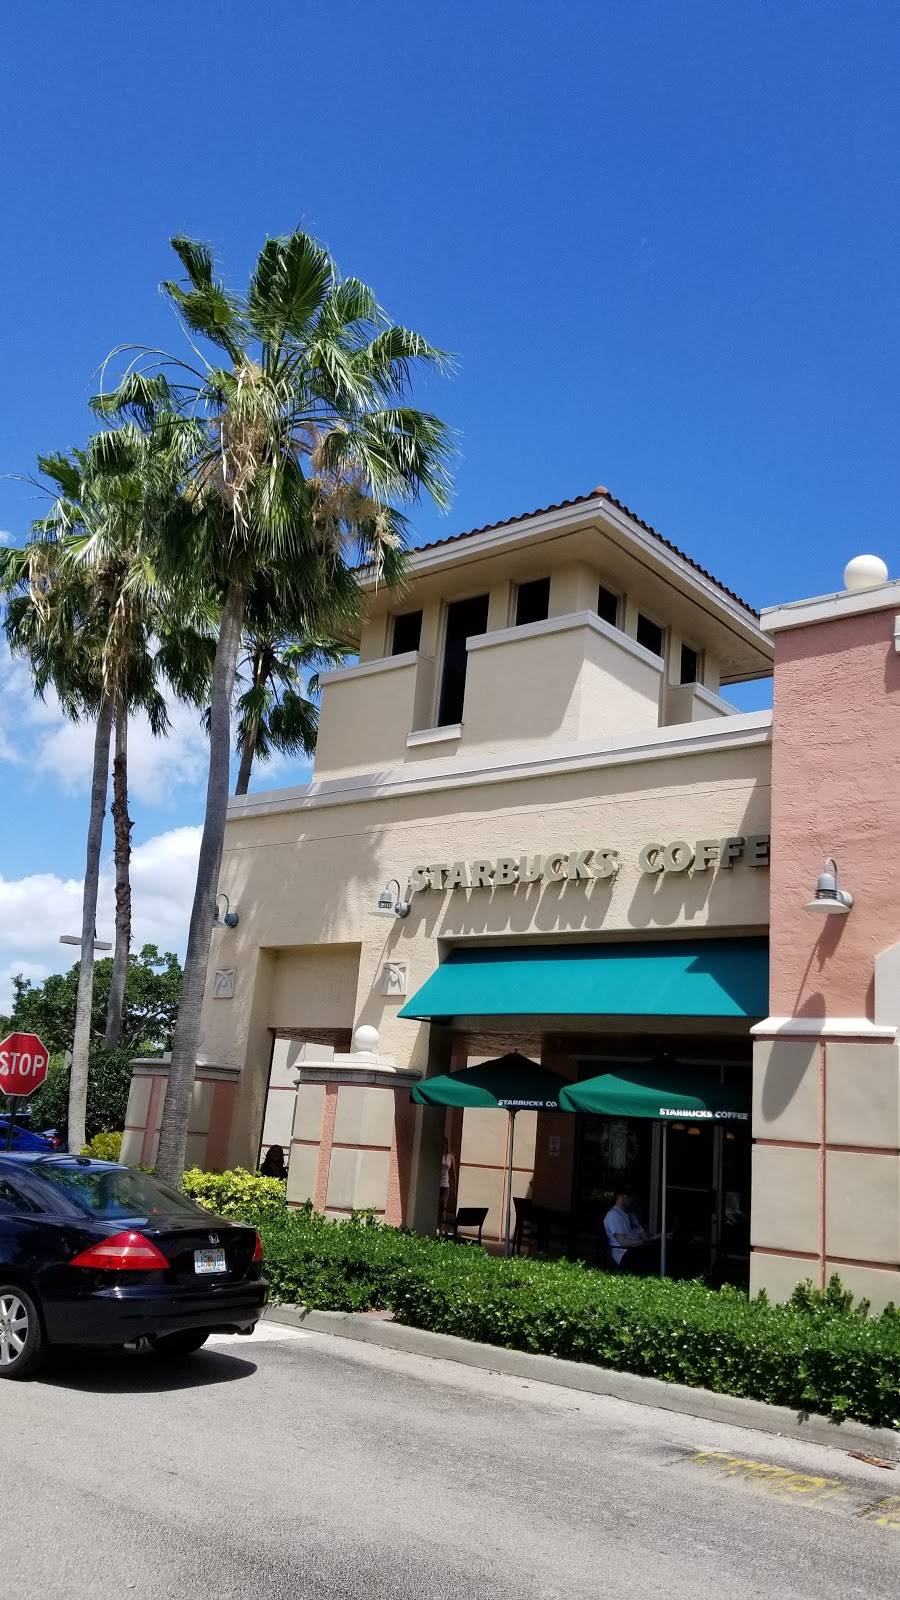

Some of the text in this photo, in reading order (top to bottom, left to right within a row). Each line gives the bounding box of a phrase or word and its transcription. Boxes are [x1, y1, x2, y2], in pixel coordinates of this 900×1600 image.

[409, 834, 769, 893] STARBUCKS COFFE
[0, 1050, 45, 1077] STOP
[498, 1099, 543, 1107] STARBUCKS
[659, 1108, 748, 1120] STARBUCKS COFFEE
